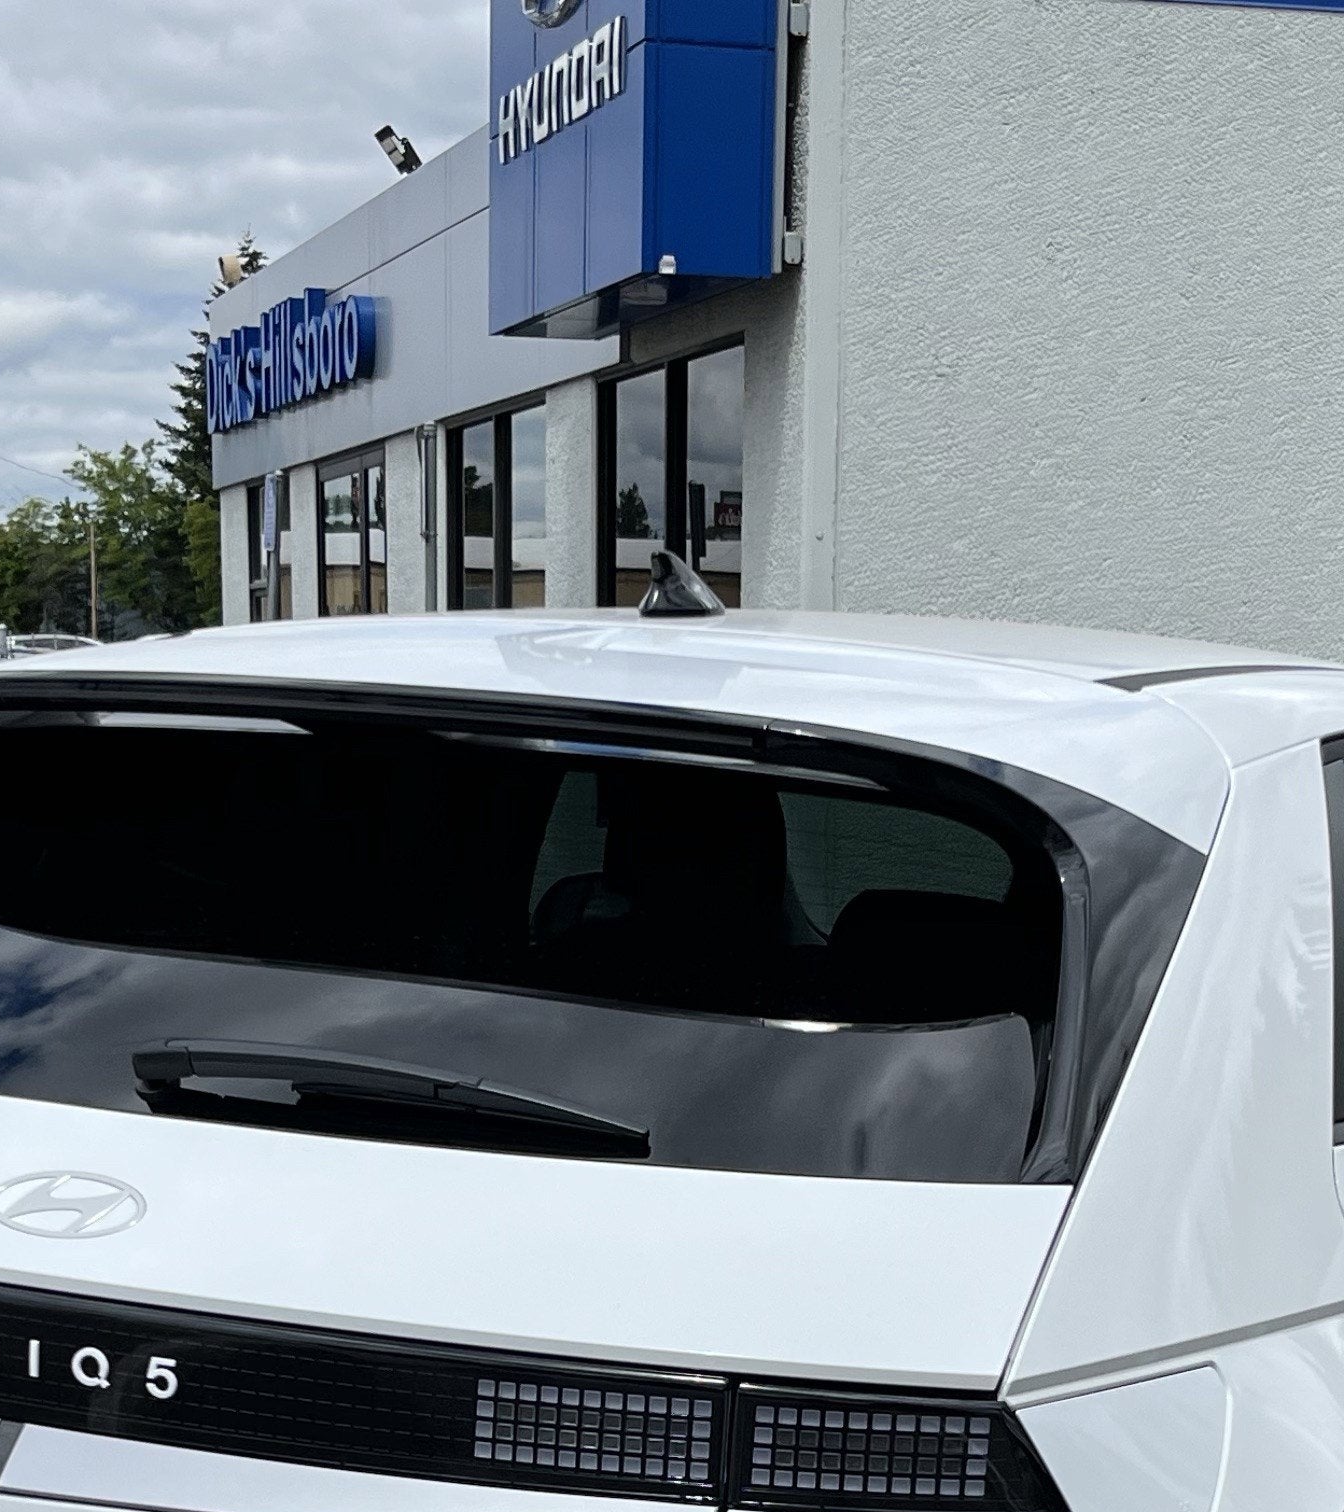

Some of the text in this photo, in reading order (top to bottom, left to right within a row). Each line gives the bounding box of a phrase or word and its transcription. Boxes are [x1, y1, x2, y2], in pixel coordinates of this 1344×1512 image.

[499, 15, 623, 165] HYUNDAI
[207, 288, 361, 435] Dick's Hillsboro
[145, 1355, 180, 1400] 5
